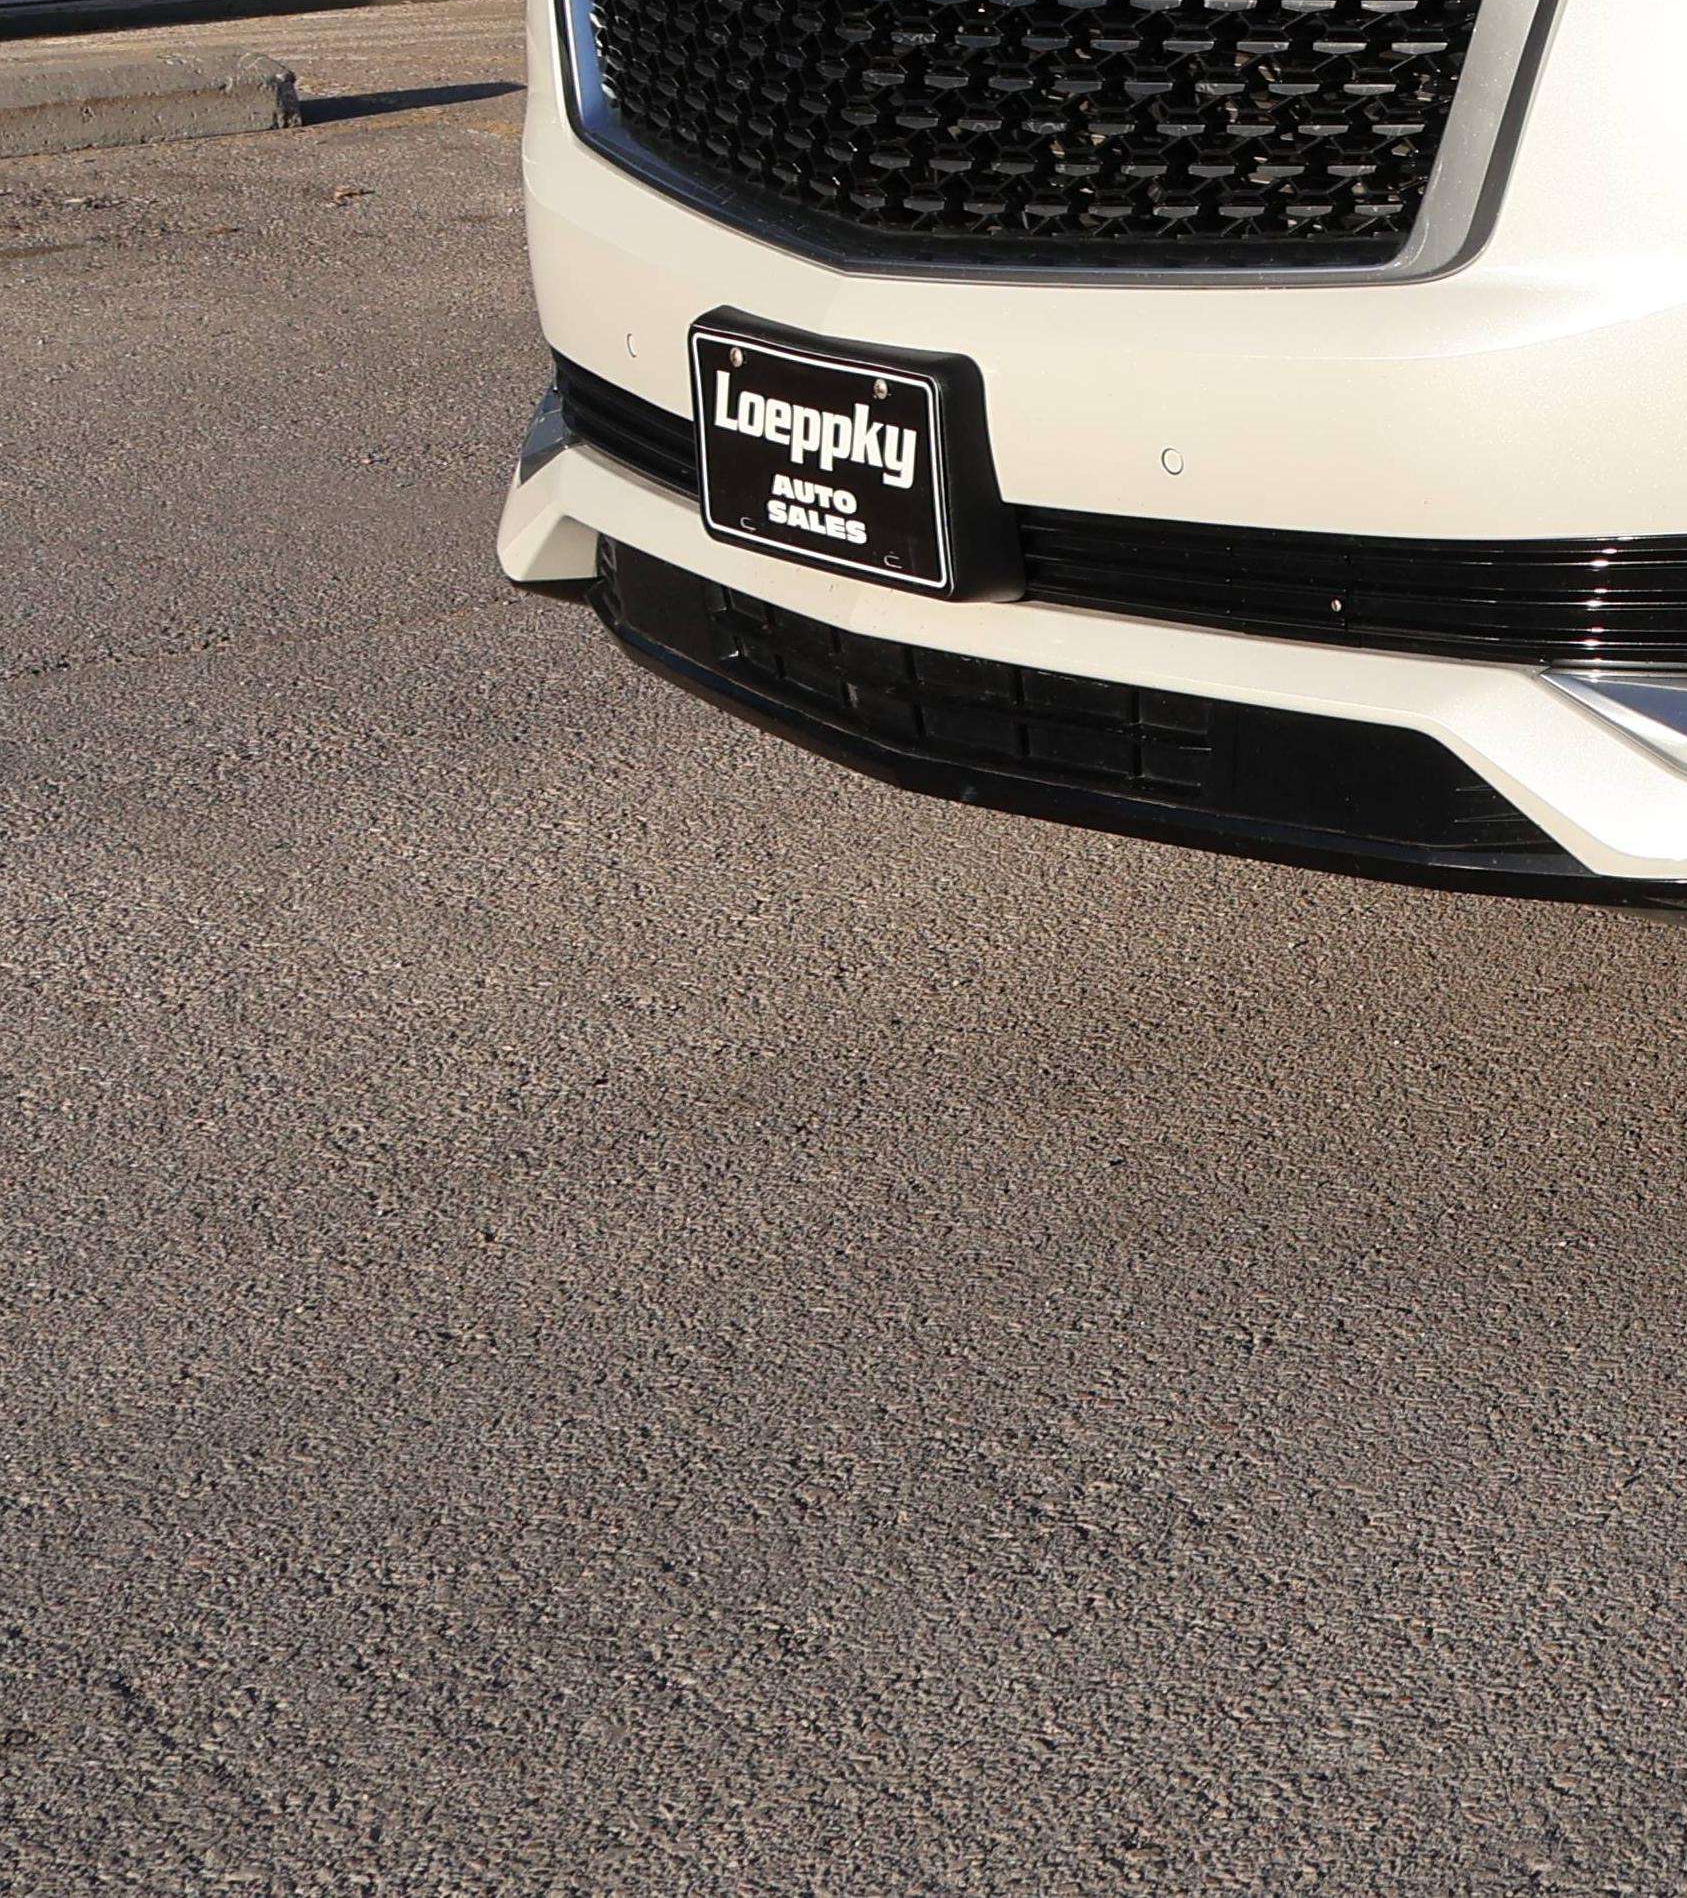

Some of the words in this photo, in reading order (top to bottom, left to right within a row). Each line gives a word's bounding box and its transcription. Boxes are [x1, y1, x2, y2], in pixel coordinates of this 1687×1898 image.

[714, 369, 917, 490] Loeppky
[771, 473, 858, 515] AUTO
[767, 499, 868, 545] SALES
